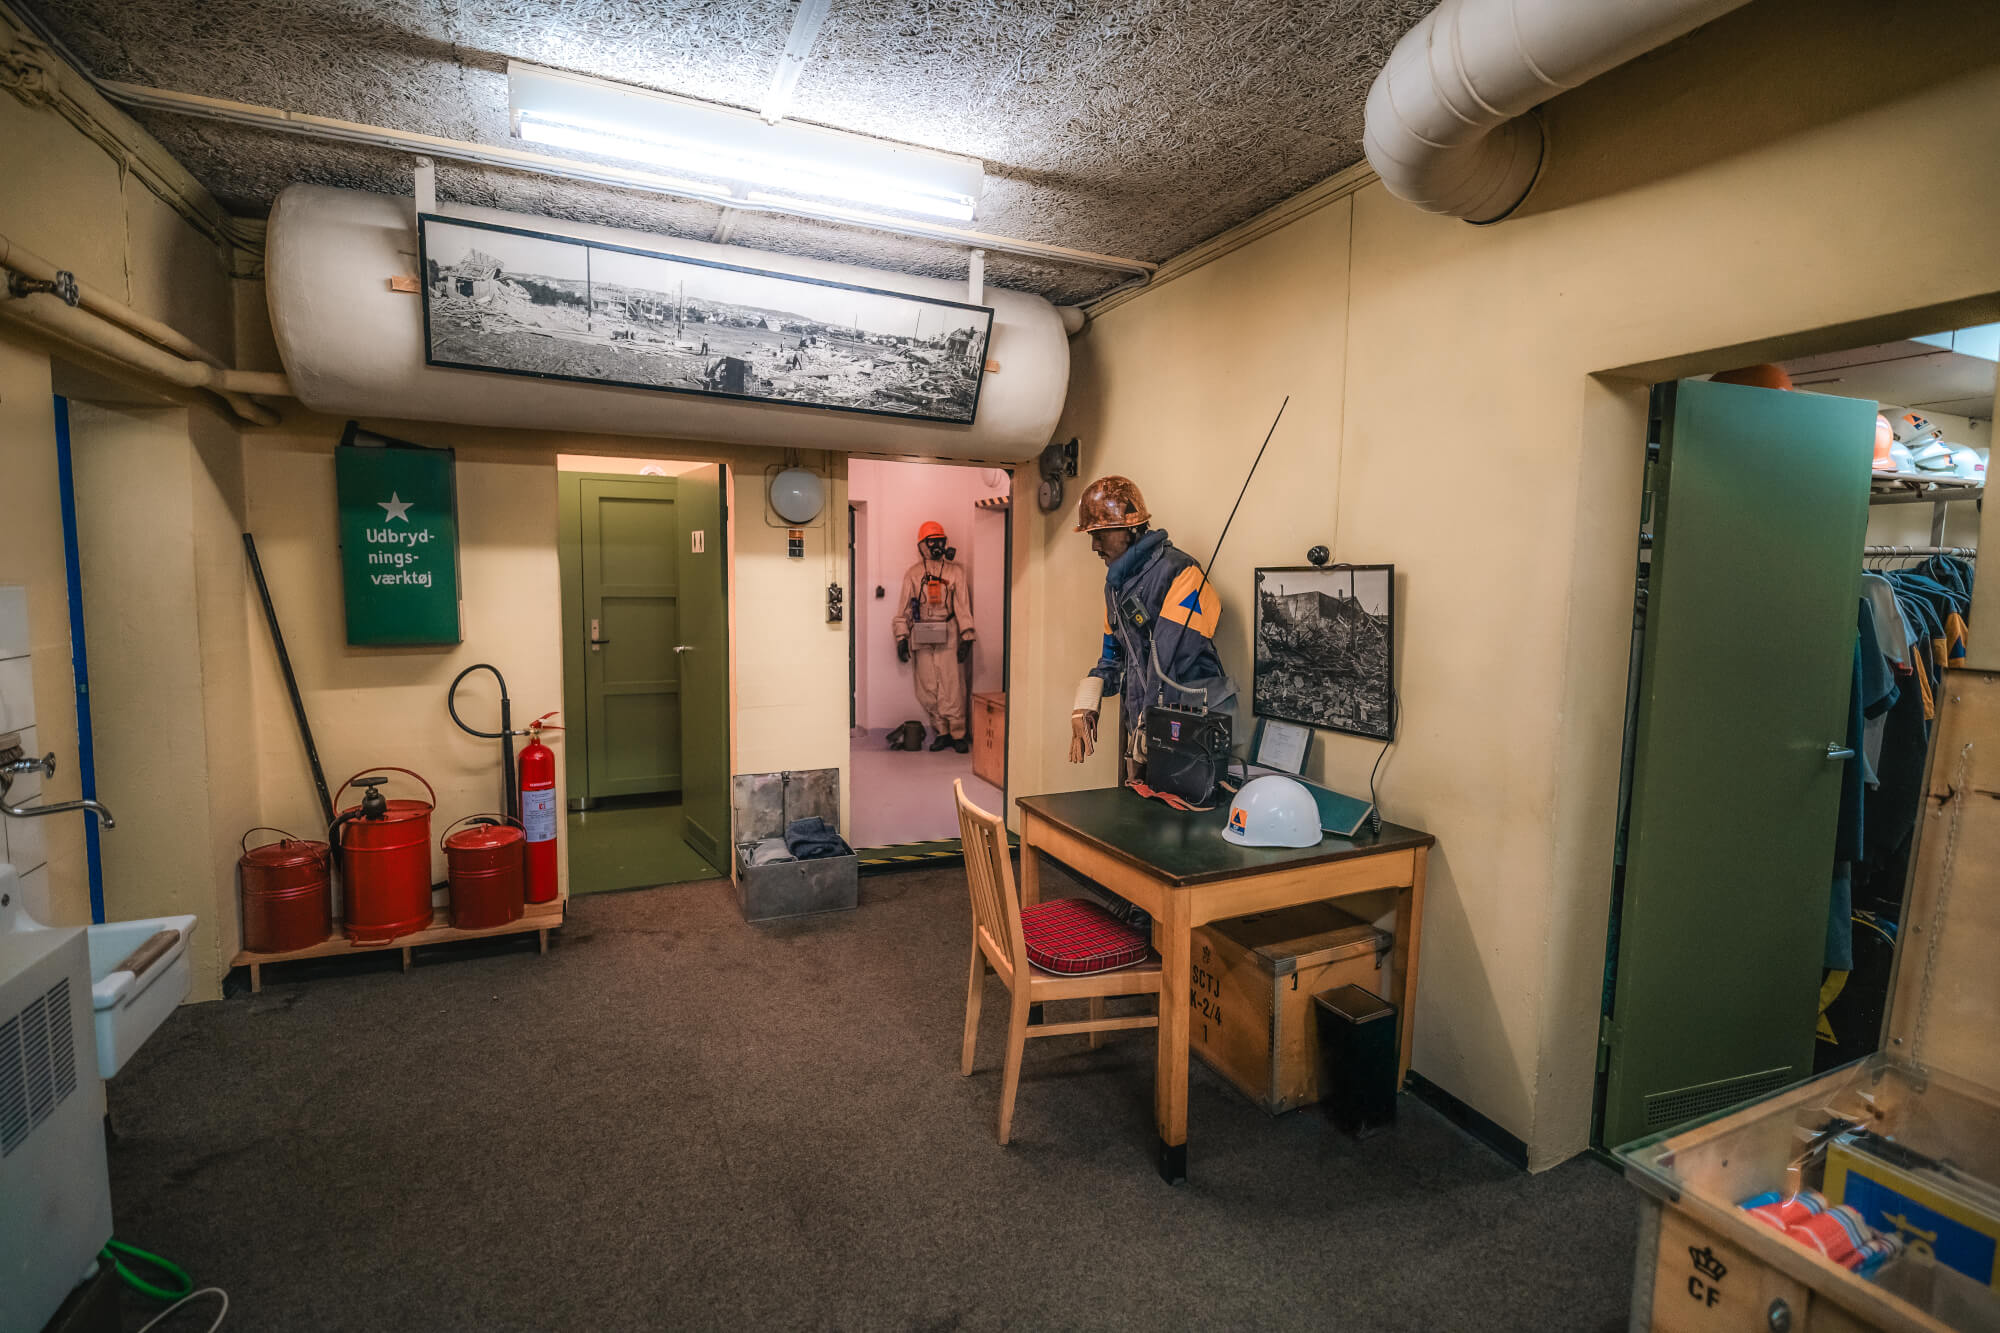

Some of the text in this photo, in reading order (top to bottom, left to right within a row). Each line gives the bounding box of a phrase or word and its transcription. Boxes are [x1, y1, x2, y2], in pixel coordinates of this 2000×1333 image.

[366, 528, 435, 547] Udbryd-
[368, 550, 419, 568] nings-
[370, 570, 432, 588] værktøj
[1192, 964, 1220, 998] SCTJ
[1190, 988, 1222, 1026] K-2/4
[1203, 1024, 1208, 1043] 1
[1688, 1275, 1720, 1308] CF
